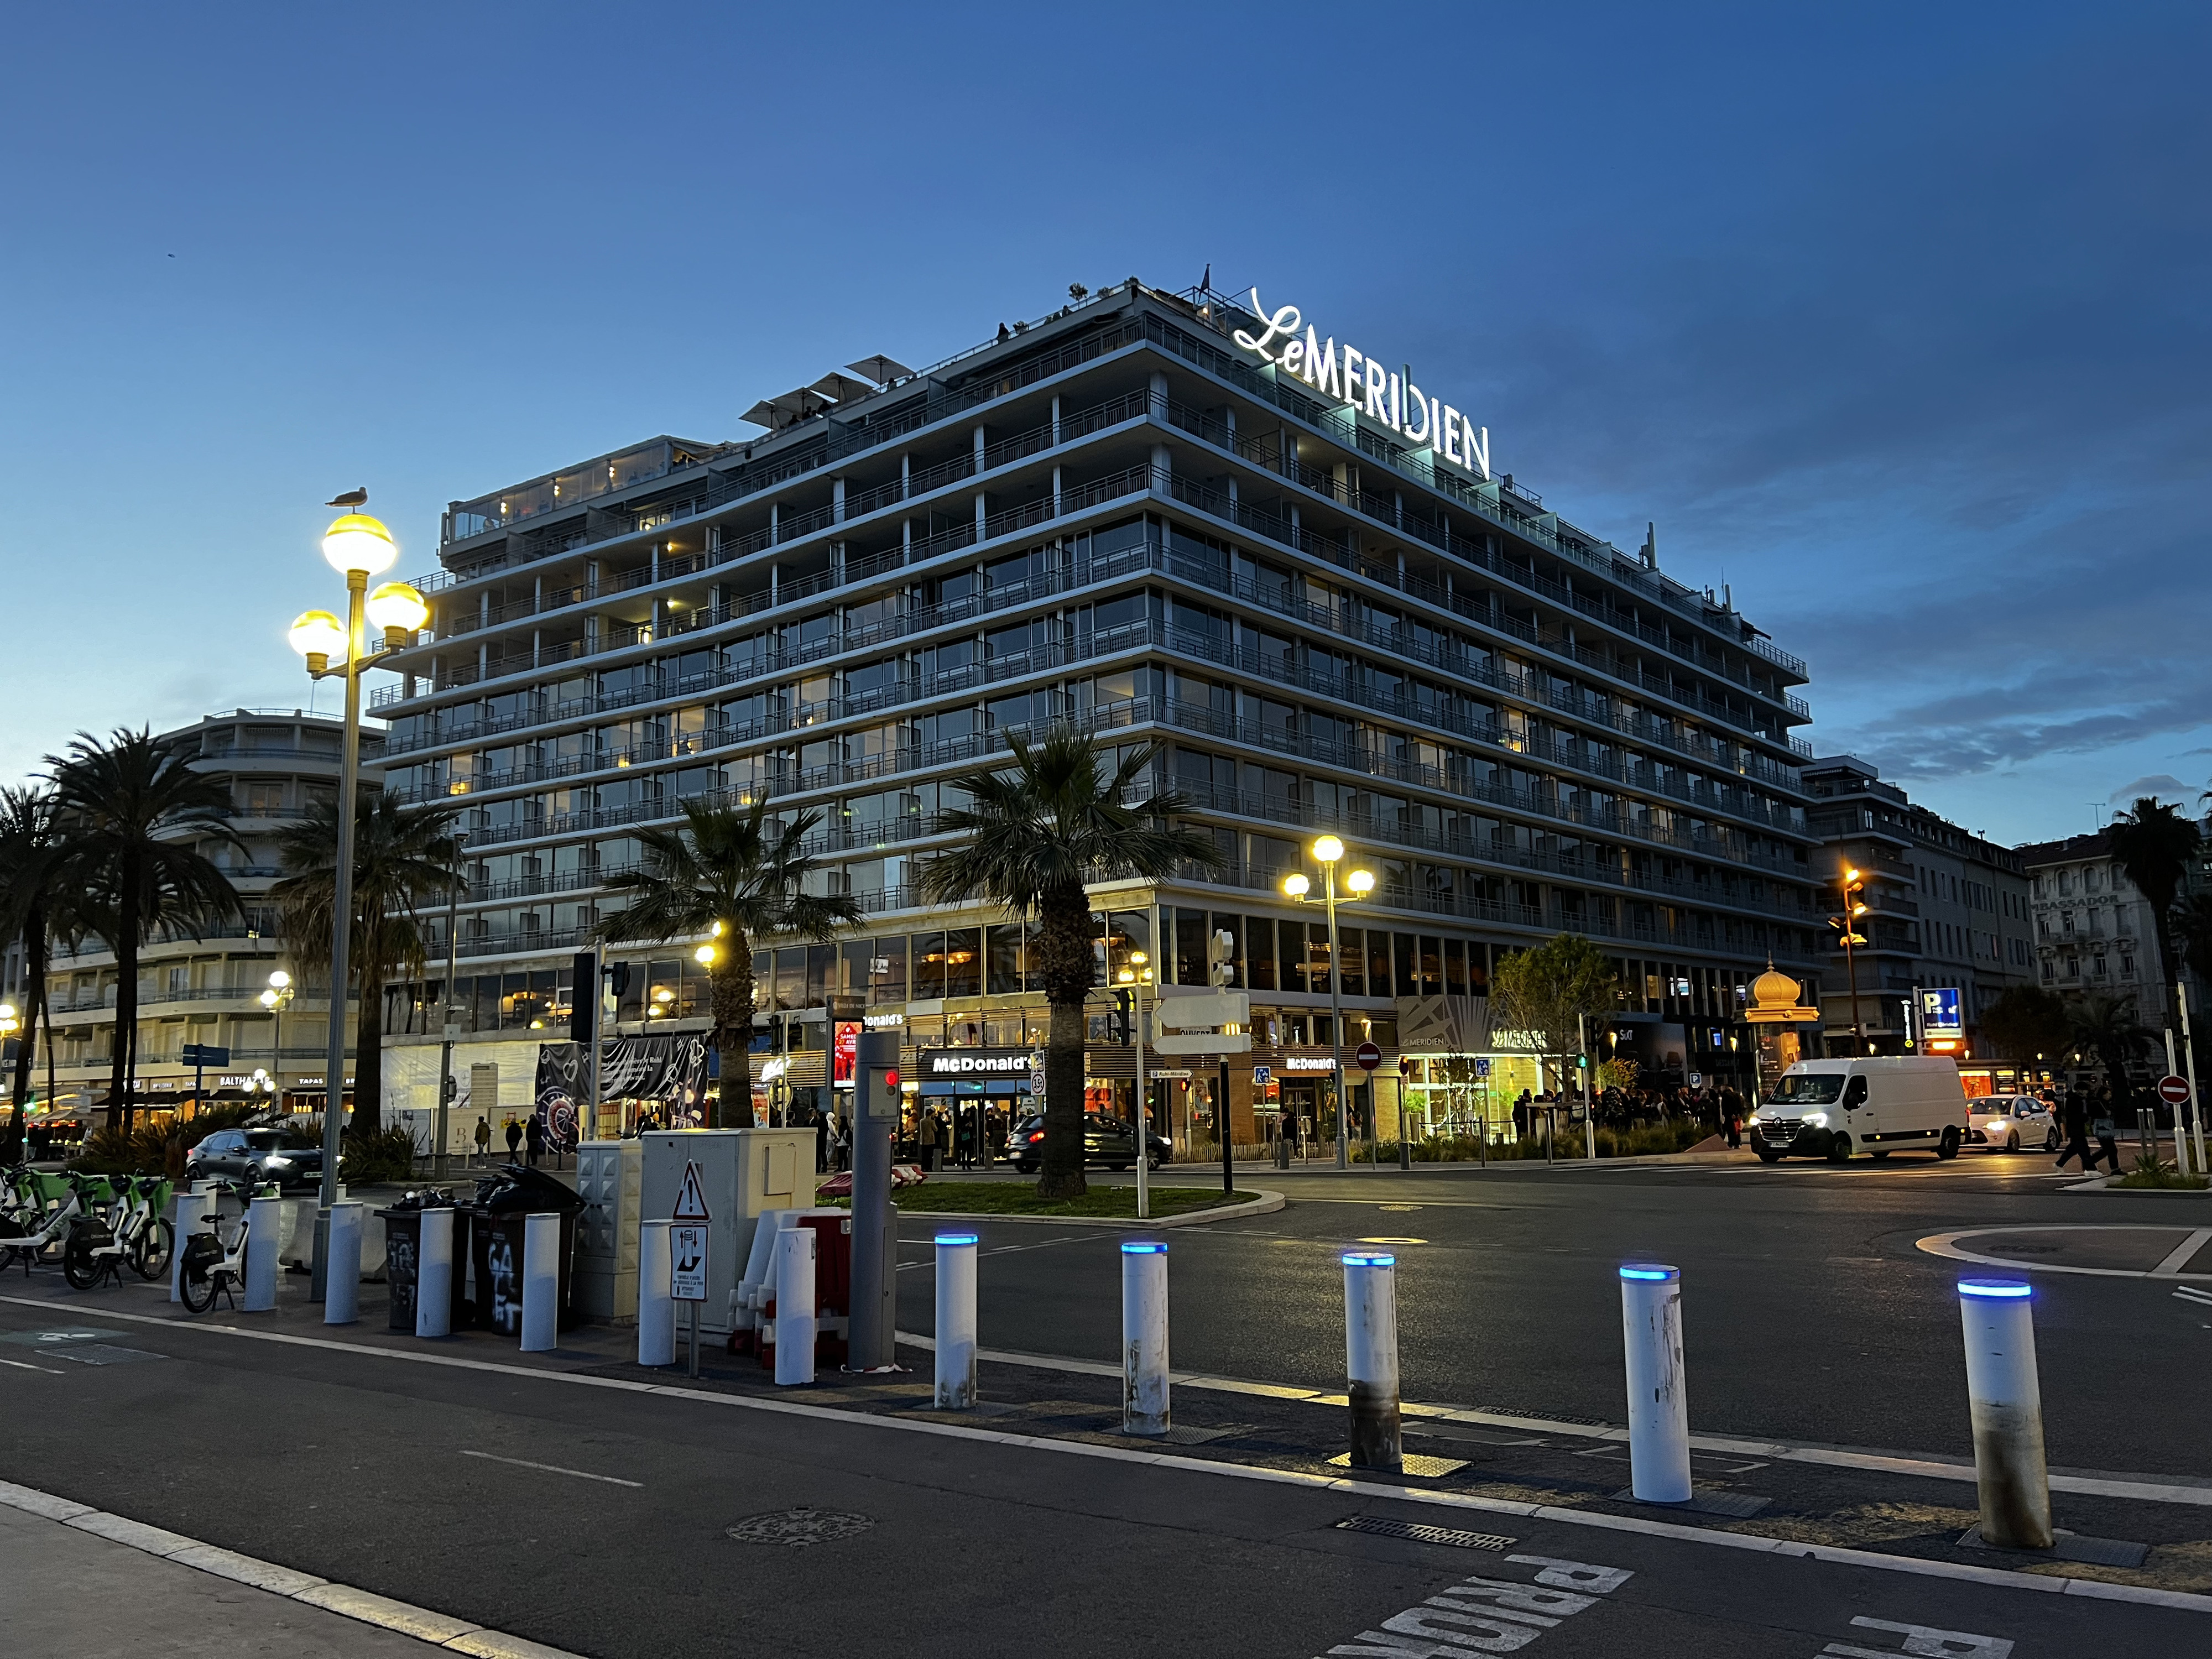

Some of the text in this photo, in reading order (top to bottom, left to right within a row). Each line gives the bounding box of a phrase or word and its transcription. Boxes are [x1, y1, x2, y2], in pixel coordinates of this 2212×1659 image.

[1234, 286, 1490, 481] Le MERIDIEN
[1924, 993, 1941, 1014] P
[1410, 1037, 1444, 1046] MERIDIEN
